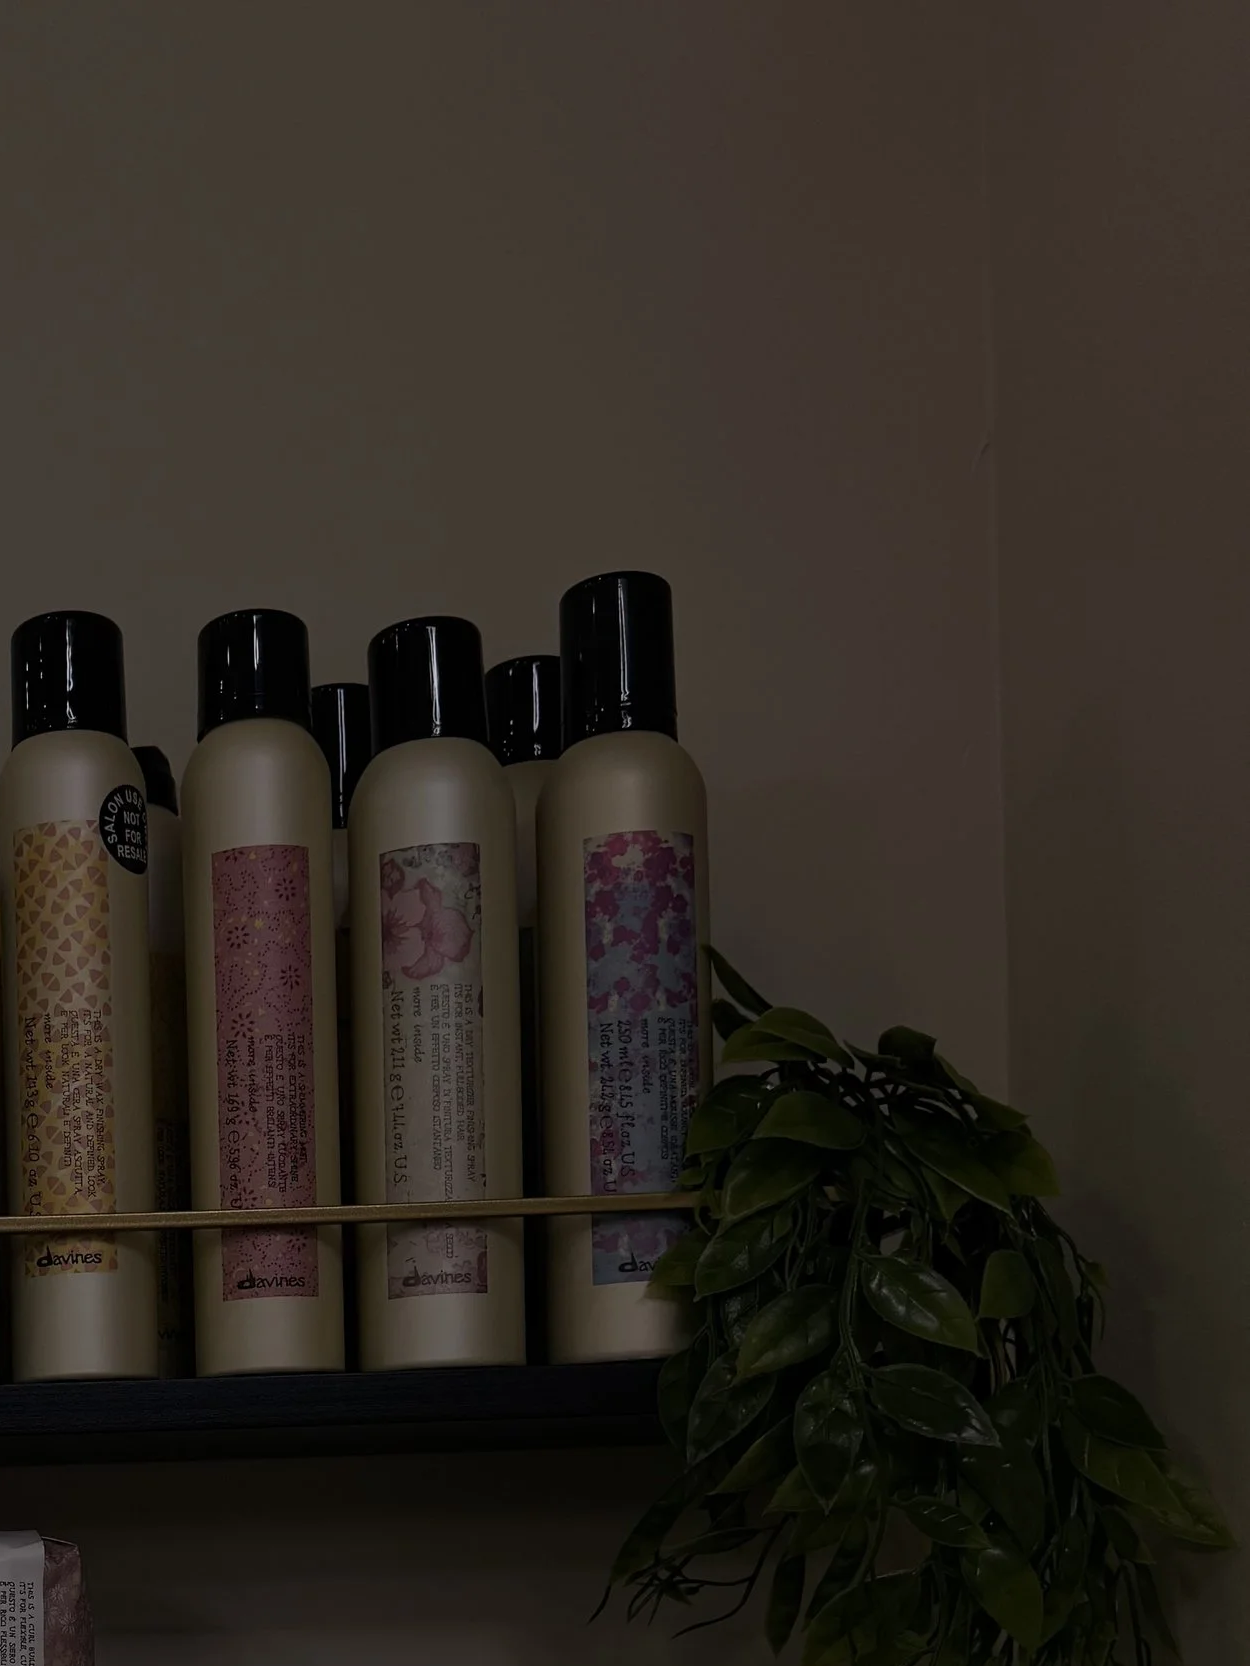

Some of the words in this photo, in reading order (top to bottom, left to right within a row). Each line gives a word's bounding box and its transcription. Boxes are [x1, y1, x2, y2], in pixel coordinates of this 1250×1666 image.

[104, 793, 124, 844] SALON
[125, 789, 142, 811] USE
[124, 810, 140, 826] NOT
[125, 829, 142, 845] FOR
[117, 844, 146, 864] RESALE
[391, 991, 404, 1020] Net
[413, 987, 423, 1017] more
[24, 1017, 36, 1045] Net
[44, 1013, 53, 1043] more
[641, 1019, 650, 1048] more
[248, 1036, 256, 1066] more
[413, 1024, 425, 1063] inside
[45, 1050, 55, 1089] inside
[95, 1059, 103, 1077] DRY
[642, 1055, 652, 1094] inside
[95, 1082, 103, 1104] WAX
[249, 1070, 257, 1112] inside
[36, 1245, 103, 1269] davines
[236, 1269, 306, 1292] davines
[402, 1265, 471, 1287] davines
